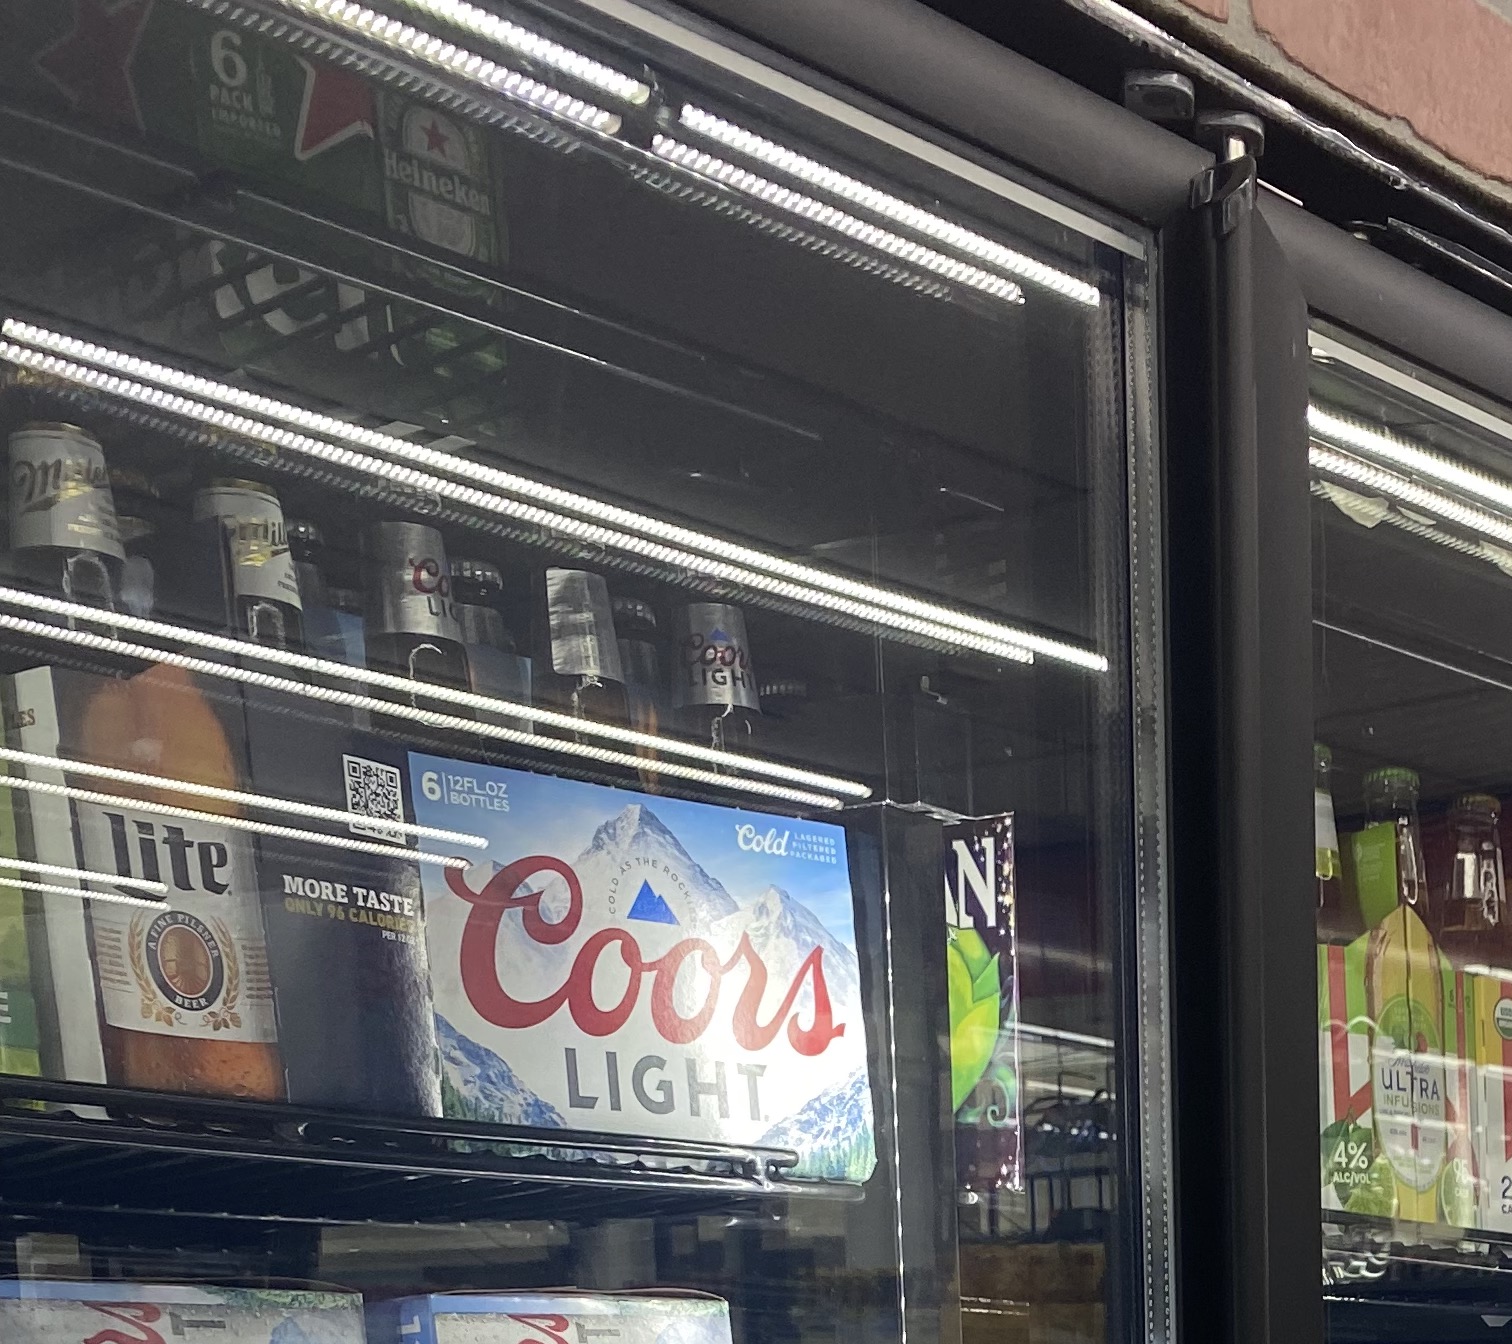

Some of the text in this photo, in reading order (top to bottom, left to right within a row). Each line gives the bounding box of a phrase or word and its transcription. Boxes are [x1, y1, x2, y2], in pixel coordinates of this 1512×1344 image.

[211, 30, 247, 87] 6
[384, 149, 490, 215] Heineken
[420, 771, 442, 801] 6
[450, 793, 510, 812] BOTTLES
[735, 823, 791, 857] Cold
[636, 857, 658, 868] THE
[283, 874, 414, 916] MORE TASTE
[284, 898, 323, 916] ONLY
[327, 903, 344, 920] 96
[178, 913, 219, 959] PILSNER
[444, 855, 845, 1056] Coors
[174, 995, 208, 1010] BEER
[564, 1047, 769, 1122] LIGHT
[1381, 1067, 1441, 1100] ULTRA
[1383, 1093, 1441, 1116] INFUSIONS
[1333, 1141, 1369, 1169] 4%
[1332, 1171, 1371, 1185] ALC/VOL
